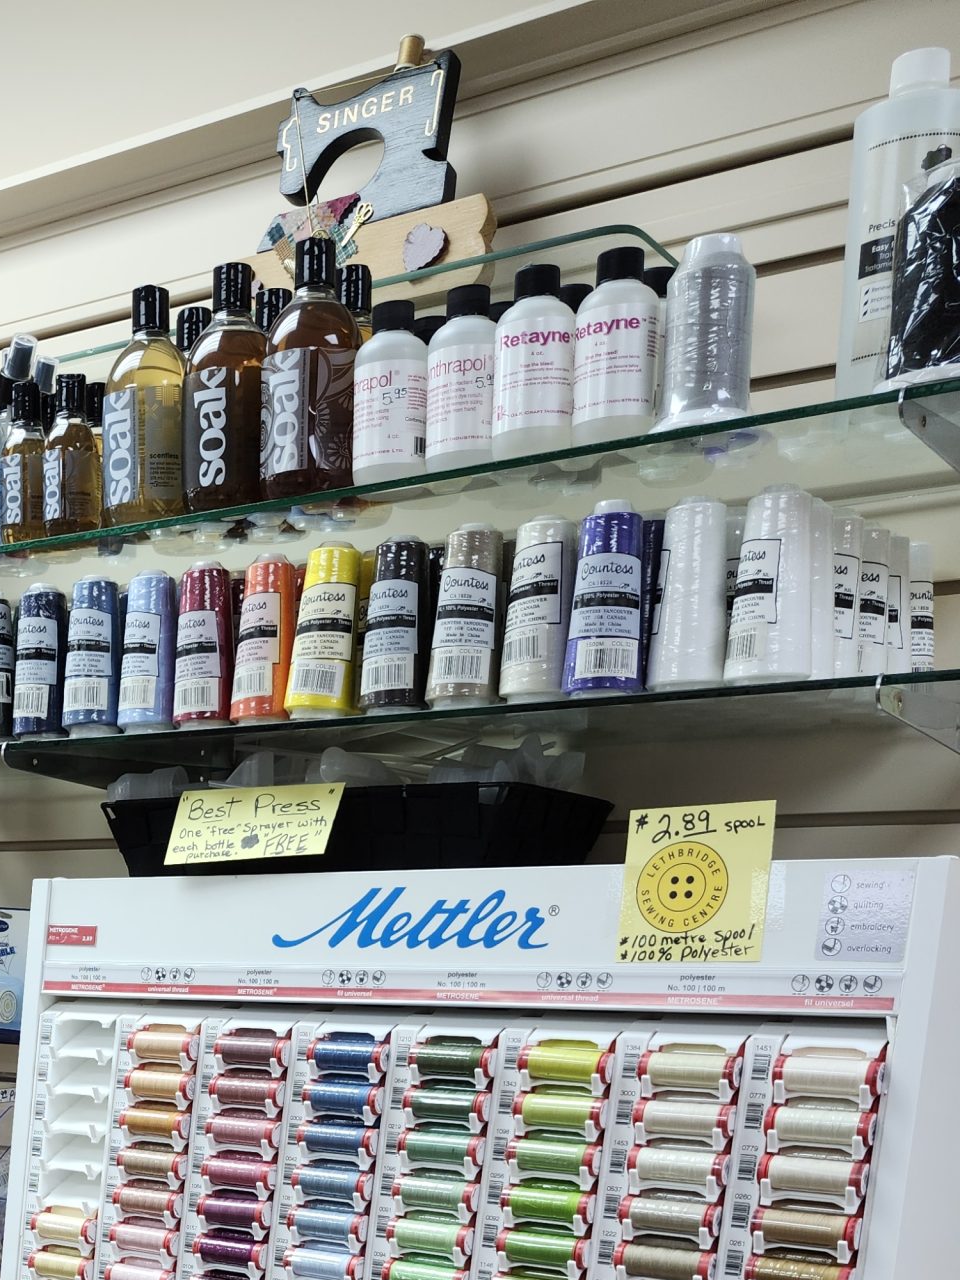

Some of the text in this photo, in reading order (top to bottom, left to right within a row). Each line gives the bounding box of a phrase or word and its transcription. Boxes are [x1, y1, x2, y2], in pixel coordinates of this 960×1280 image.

[317, 86, 415, 134] SINGER
[868, 219, 896, 233] Precis
[575, 317, 641, 341] Retayne
[500, 331, 570, 351] Retayne
[430, 354, 486, 380] nthrapol
[269, 348, 300, 474] soak
[193, 366, 227, 488] soak
[105, 389, 132, 506] soak
[5, 453, 21, 524] soak
[43, 449, 60, 521] soak
[581, 562, 634, 581] Countess
[444, 575, 489, 592] Countess
[179, 828, 203, 839] One
[242, 821, 292, 836] Sprayer
[297, 816, 327, 828] with
[172, 844, 198, 853] each
[205, 839, 235, 850] bottle
[646, 848, 721, 878] LETHBRIDGE
[856, 881, 884, 890] sewing
[641, 885, 722, 928] SEWING CENTRE
[853, 901, 884, 910] quilting
[272, 886, 549, 949] Mettler
[661, 931, 707, 946] metre
[846, 944, 892, 954] overlocking
[680, 944, 755, 963] Polyester
[447, 971, 477, 979] polyester
[680, 974, 716, 982] polyester
